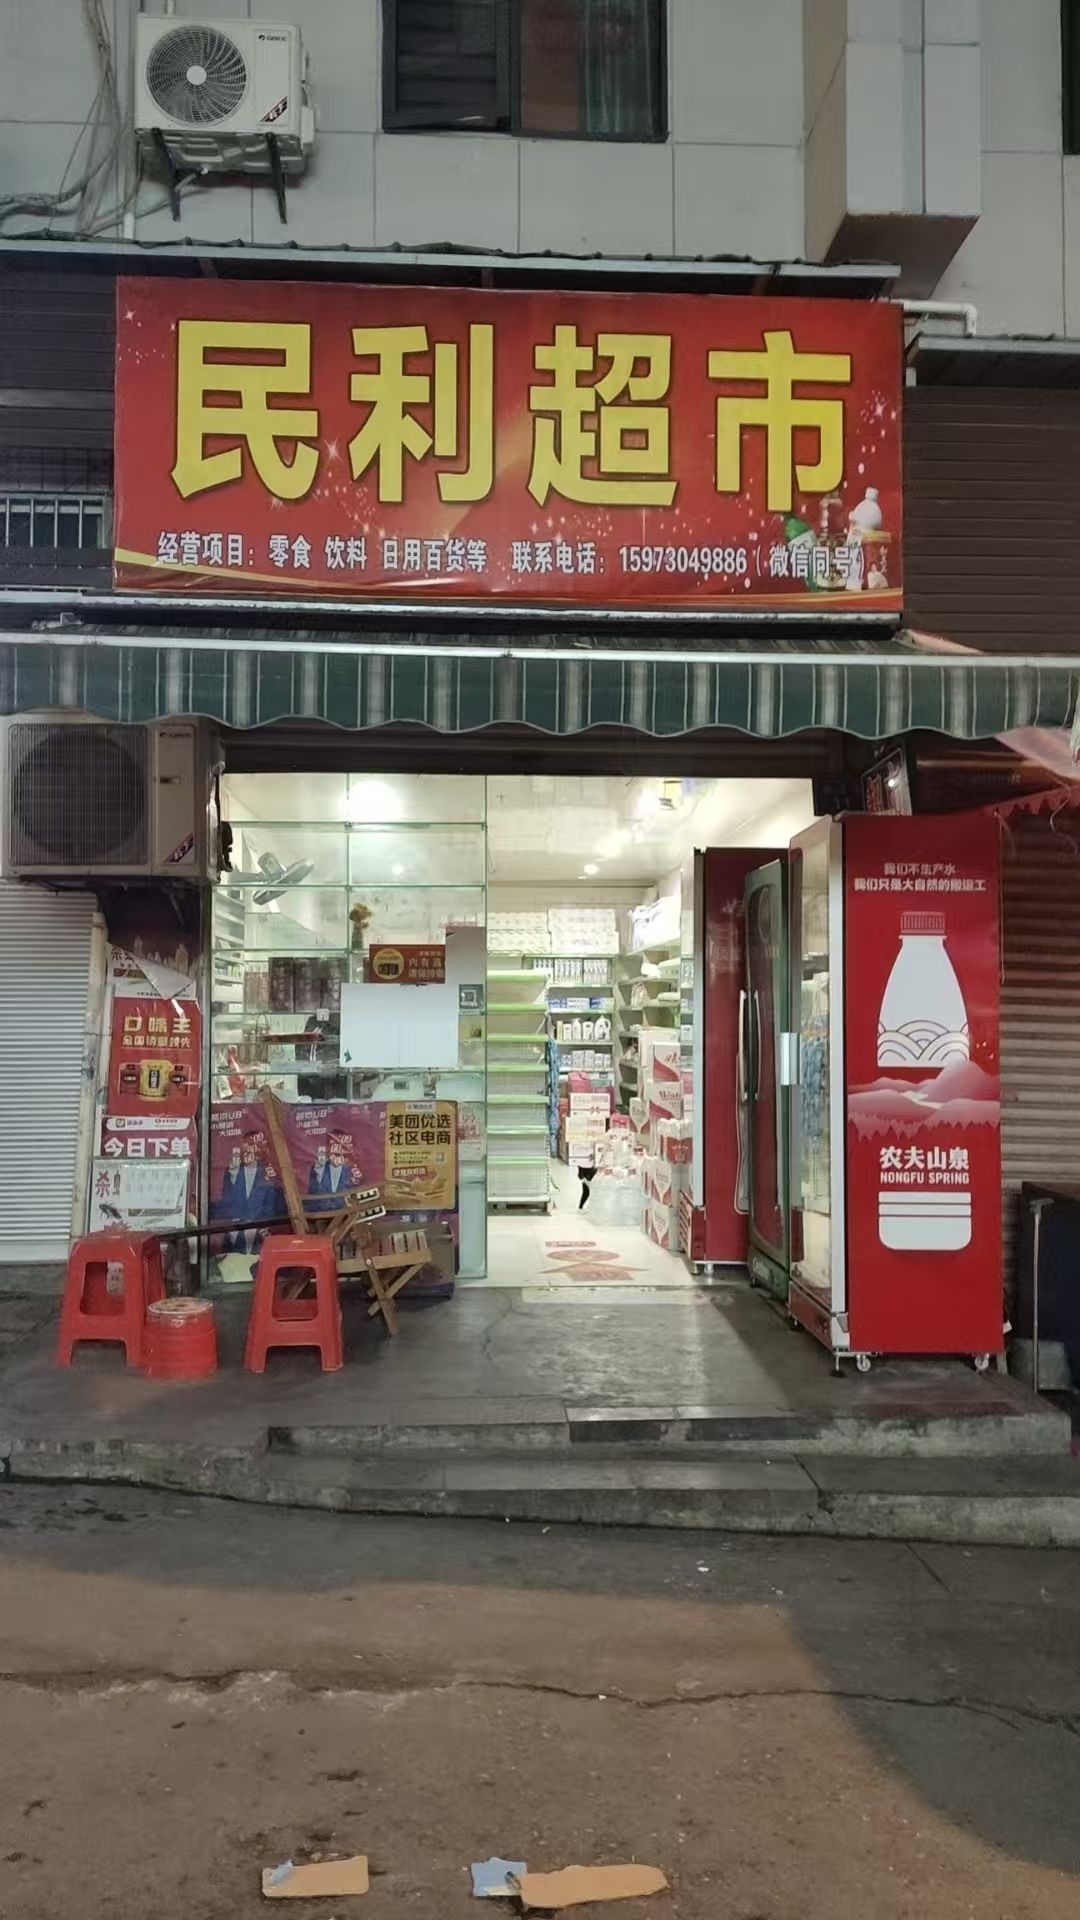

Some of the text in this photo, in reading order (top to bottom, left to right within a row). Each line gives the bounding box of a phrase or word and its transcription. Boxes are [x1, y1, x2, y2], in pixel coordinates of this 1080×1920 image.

[169, 320, 852, 512] 民利超市
[268, 533, 312, 569] 零食
[325, 535, 368, 570] 饮料
[382, 538, 488, 573] 日用百货等
[619, 545, 748, 574] 15973049886
[884, 862, 956, 876] 我们不生产水
[854, 877, 987, 891] 我们只是大自然的搬运工
[122, 1035, 191, 1048] 全国销量领先
[389, 1113, 452, 1129] 美团优选
[388, 1130, 451, 1146] 社区电商
[104, 1137, 192, 1158] 今日下单
[879, 1145, 970, 1170] 农夫山泉
[95, 1170, 111, 1198] 杀
[880, 1171, 970, 1185] NONGFU SPRING
